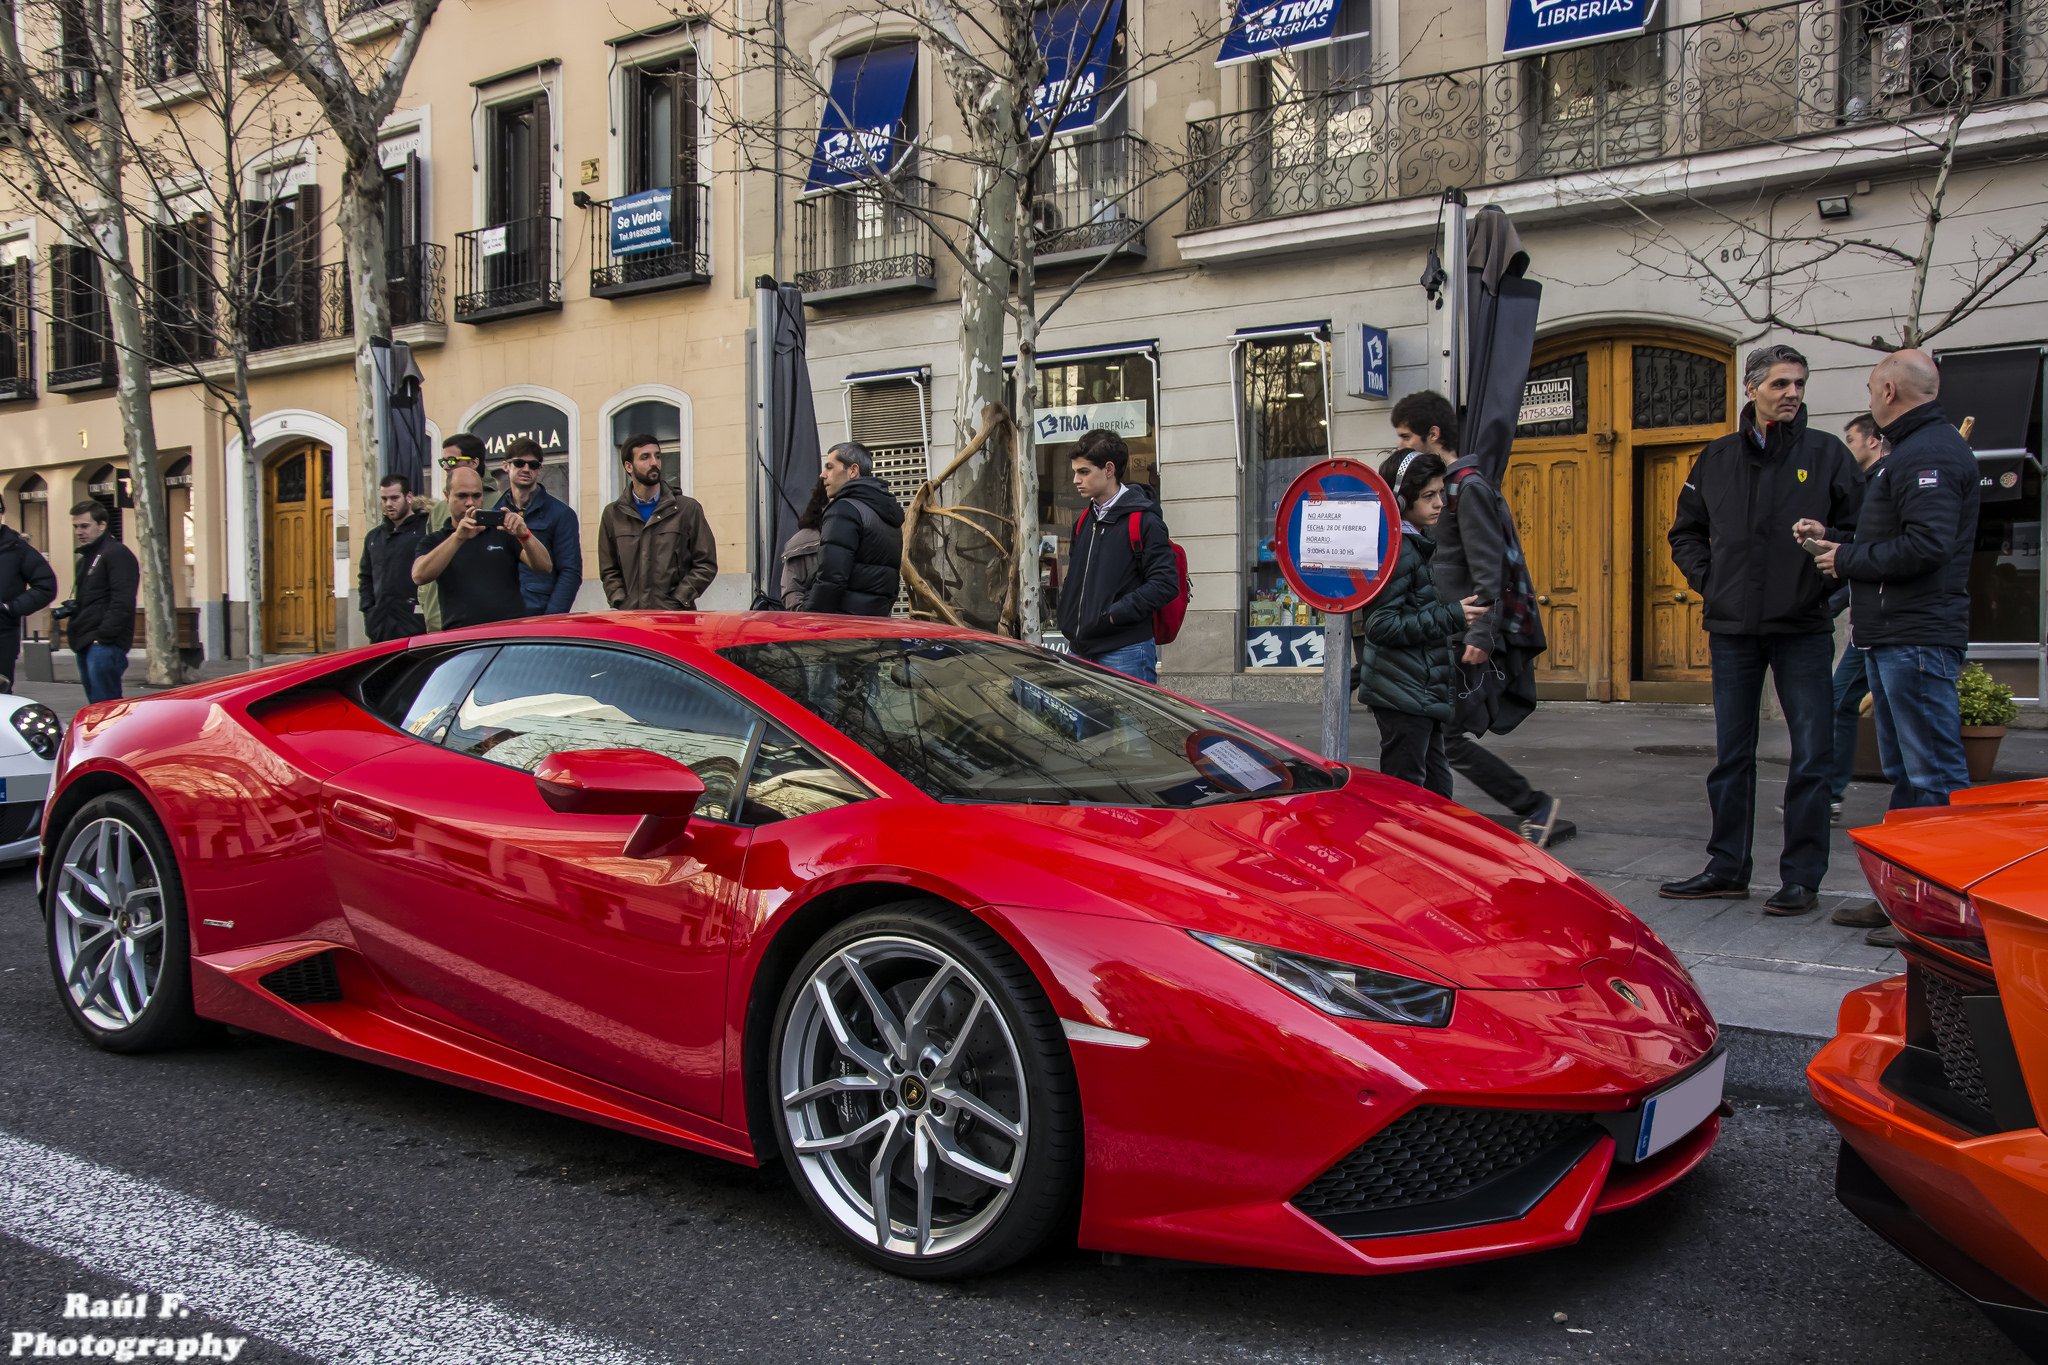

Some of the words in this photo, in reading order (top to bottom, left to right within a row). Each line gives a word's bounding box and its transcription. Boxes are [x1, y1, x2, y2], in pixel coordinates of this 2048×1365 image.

[1278, 0, 1334, 24] TROA
[617, 216, 630, 230] Se
[631, 208, 662, 226] Vende
[1721, 247, 1742, 263] 80
[1367, 370, 1384, 392] TROA
[1530, 381, 1569, 395] ALQUILA
[1518, 405, 1572, 421] 917583826
[1059, 414, 1089, 432] TROA
[1307, 512, 1316, 520] NO
[1317, 512, 1342, 520] APARCAR
[1342, 524, 1367, 532] FEBRERO
